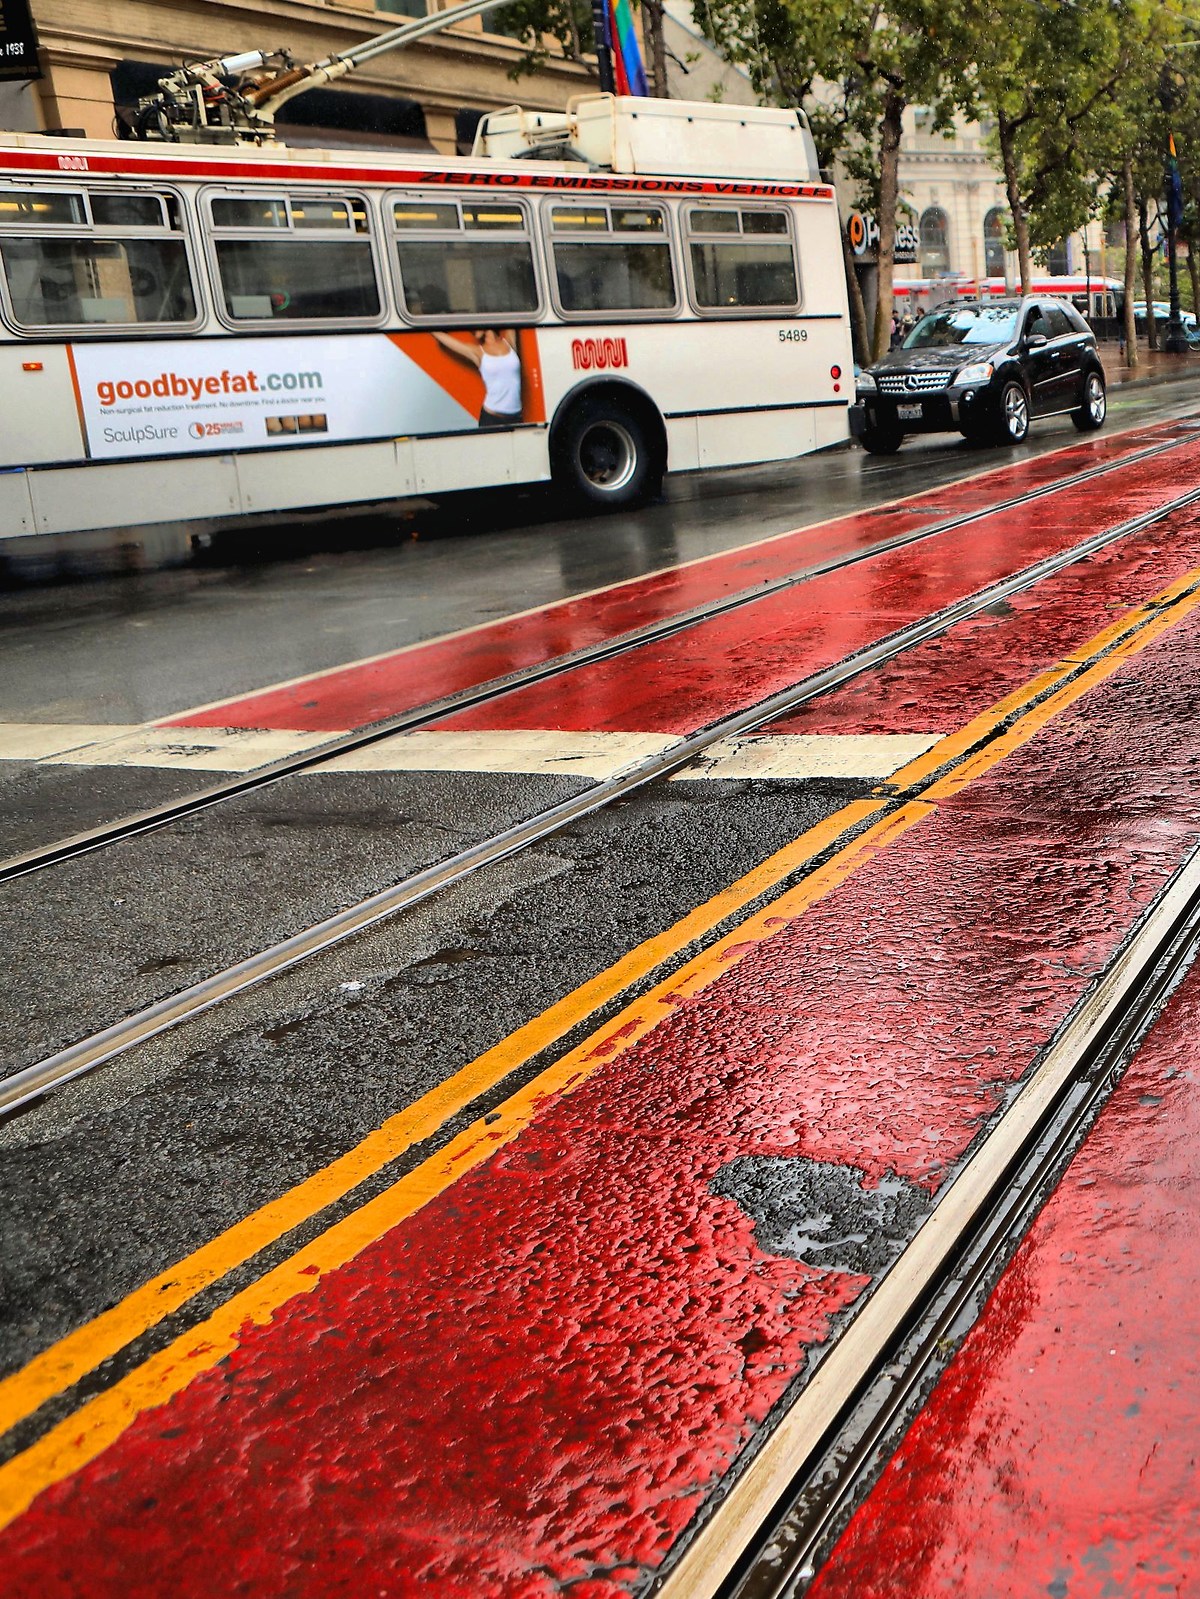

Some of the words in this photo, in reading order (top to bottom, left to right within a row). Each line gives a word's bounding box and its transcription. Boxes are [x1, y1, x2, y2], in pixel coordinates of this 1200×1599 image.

[419, 172, 520, 186] ZERO
[530, 175, 708, 192] EMISSIONS
[713, 182, 832, 198] VEHICLE
[779, 329, 808, 341] 5489
[97, 370, 323, 406] goodbyefat.com
[103, 425, 178, 443] SculpSure
[206, 422, 221, 435] 25
